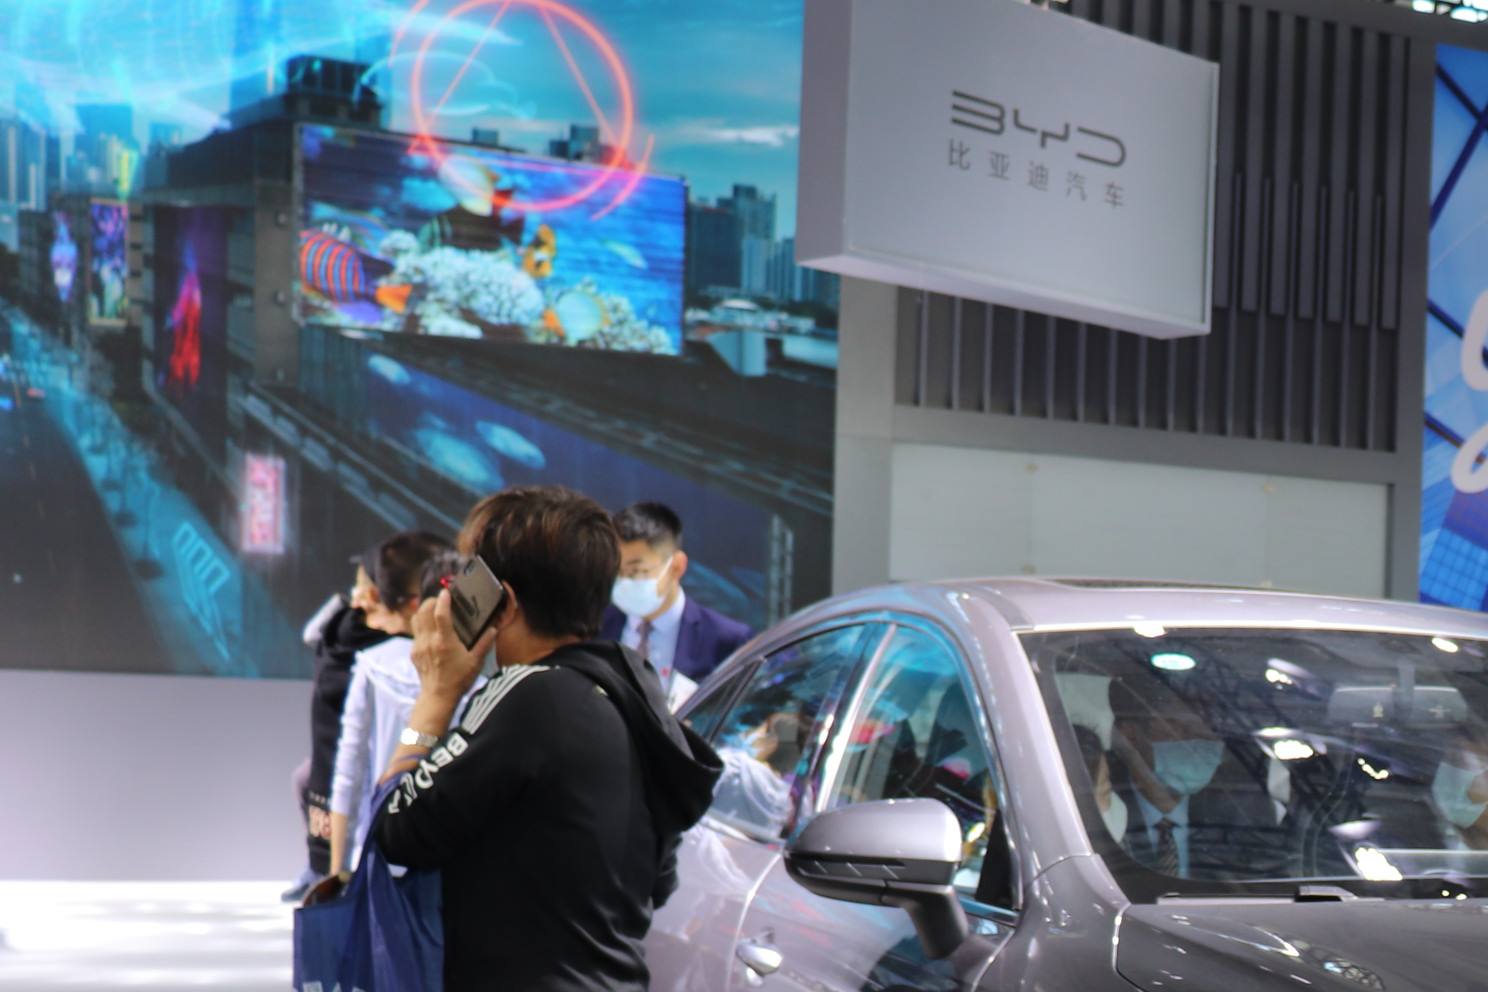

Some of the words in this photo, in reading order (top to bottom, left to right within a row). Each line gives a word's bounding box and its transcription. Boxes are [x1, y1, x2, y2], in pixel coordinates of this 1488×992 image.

[951, 89, 1127, 168] BYD
[948, 138, 1125, 209] 比亚迪汽车
